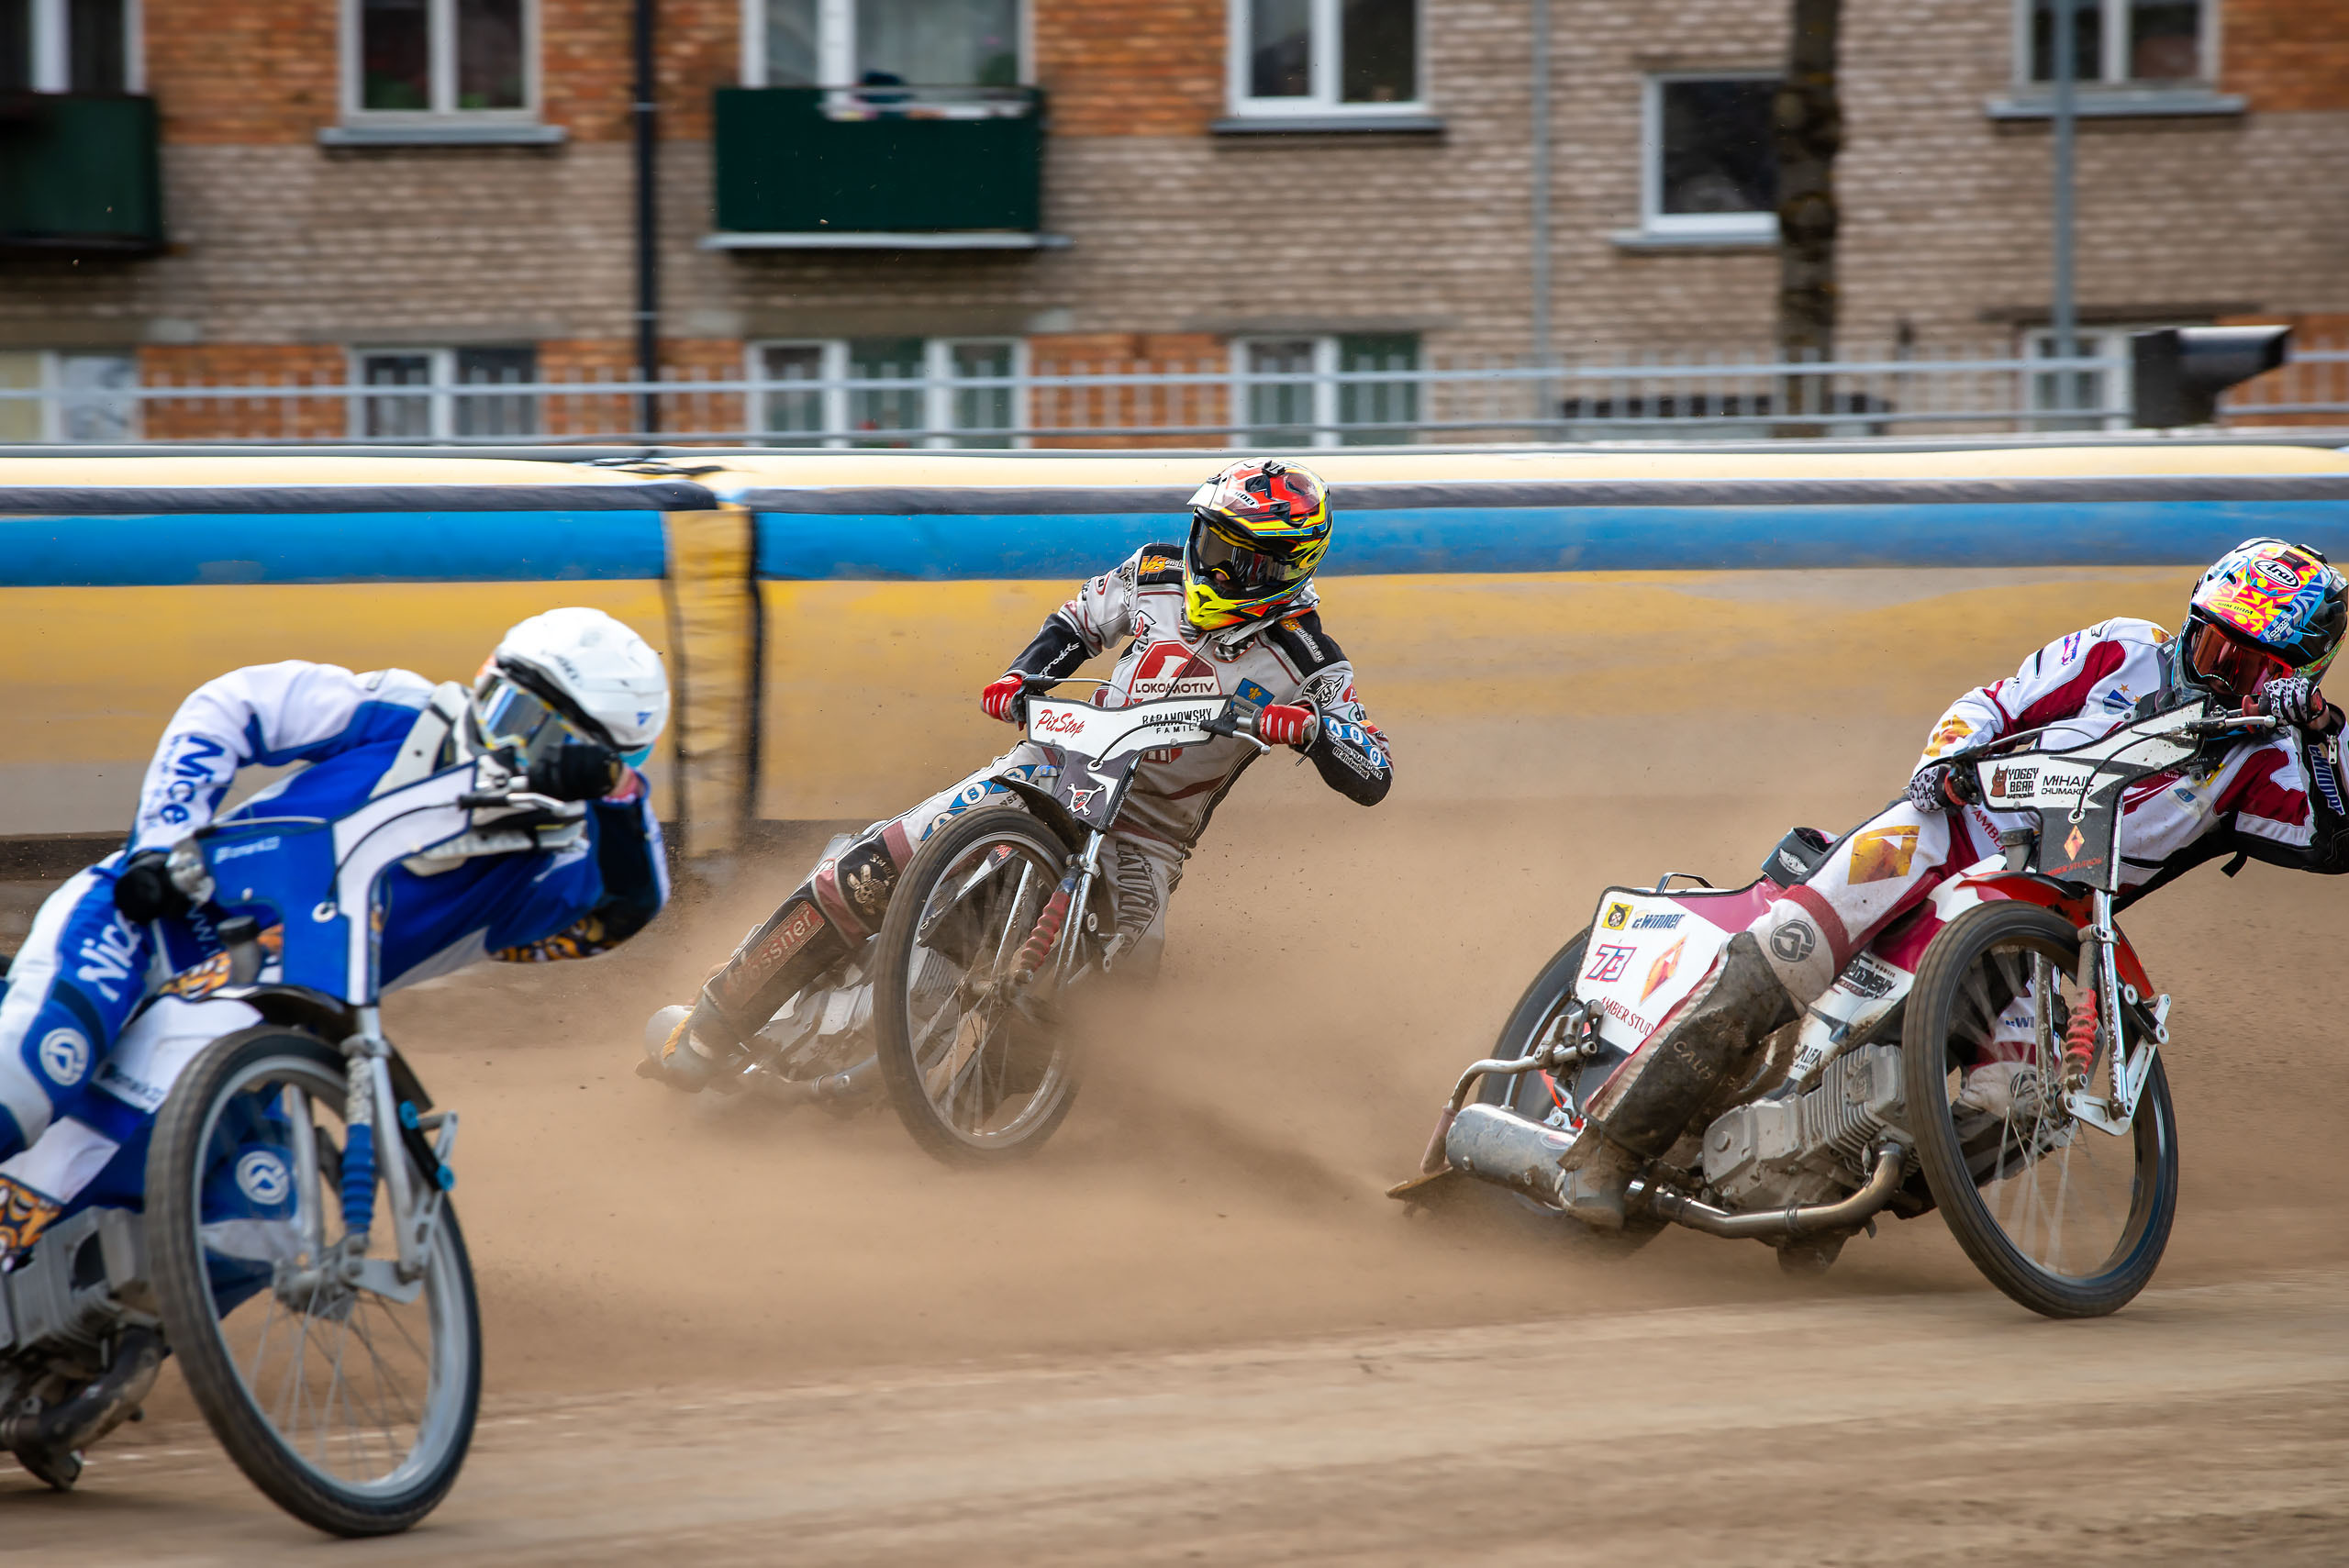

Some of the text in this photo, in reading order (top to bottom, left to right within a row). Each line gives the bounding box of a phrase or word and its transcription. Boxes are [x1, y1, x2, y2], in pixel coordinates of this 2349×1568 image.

[1138, 555, 1167, 575] V8
[2256, 562, 2295, 584] Arai
[1135, 683, 1215, 695] LOKOMOTIV
[161, 735, 225, 825] Nice
[2008, 768, 2039, 780] YOGGY
[2043, 775, 2095, 786] MIHAIL
[2009, 781, 2033, 792] BEAR
[1586, 944, 1637, 982] 73
[1601, 996, 1631, 1024] AMBER
